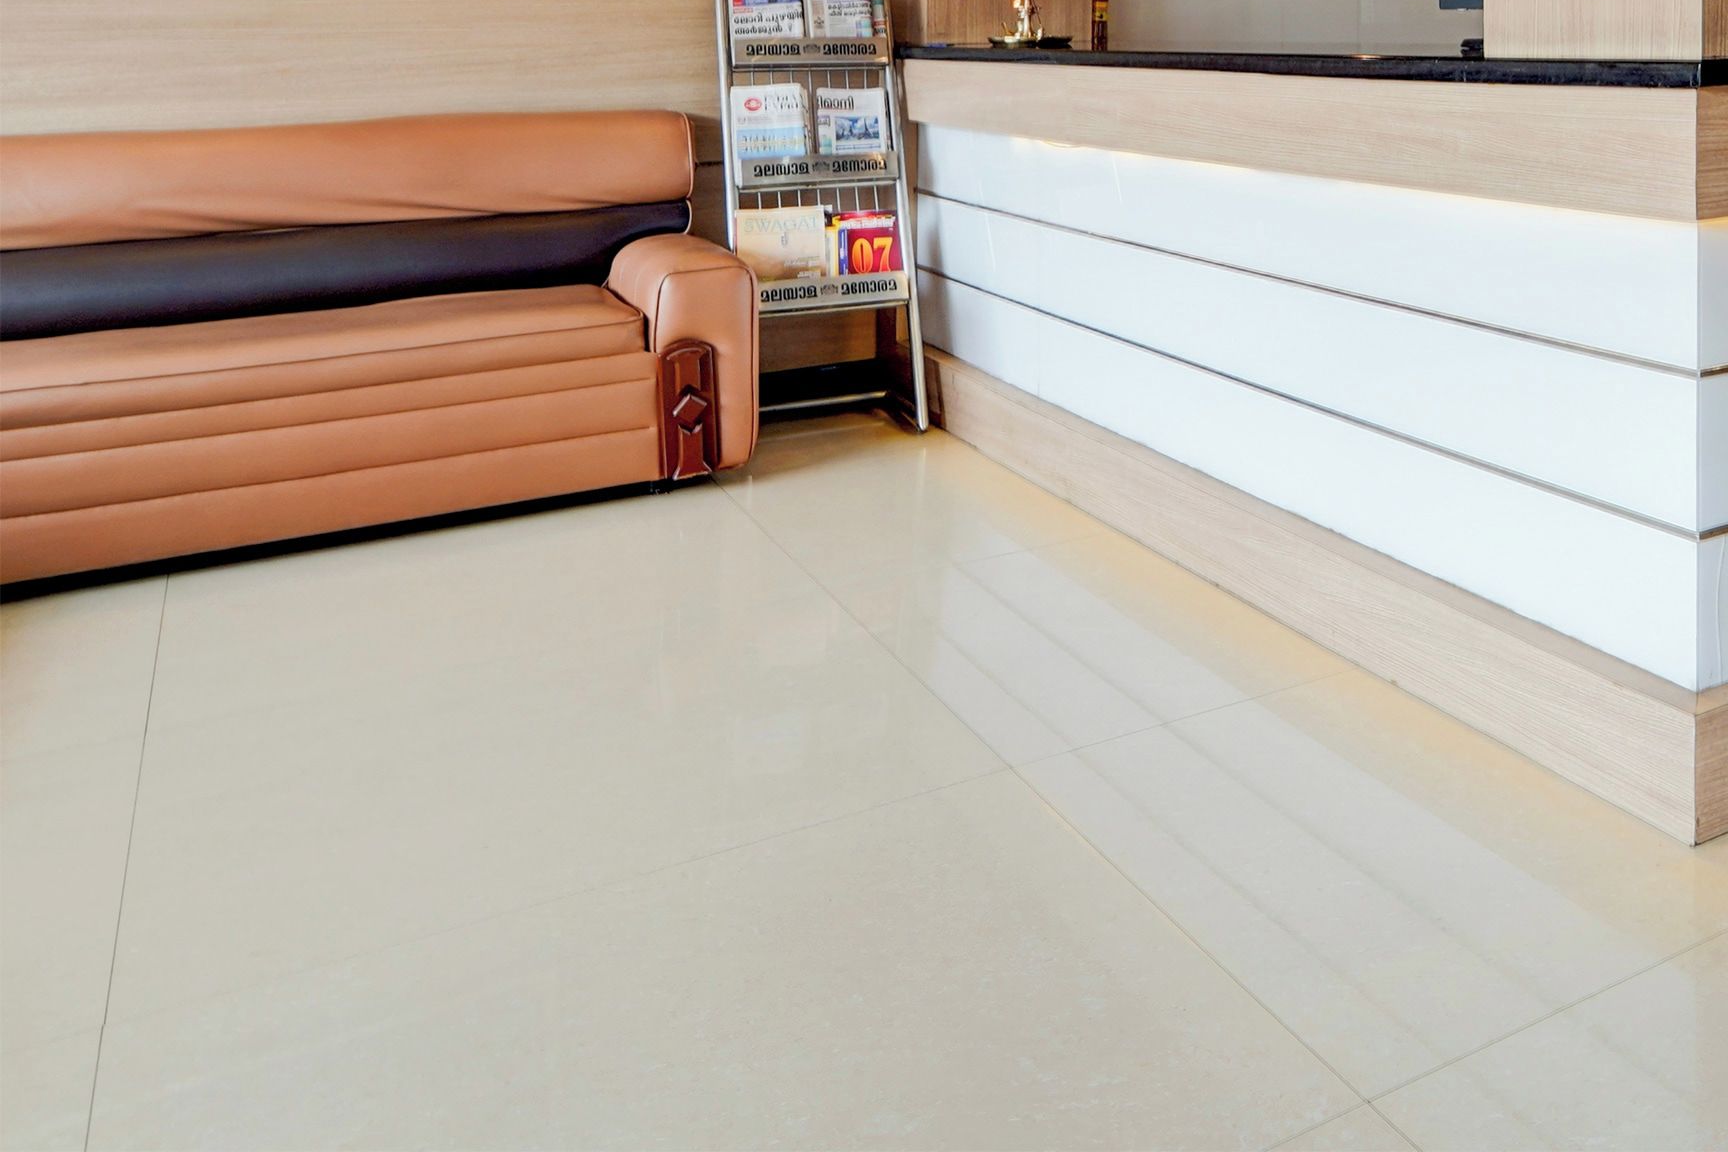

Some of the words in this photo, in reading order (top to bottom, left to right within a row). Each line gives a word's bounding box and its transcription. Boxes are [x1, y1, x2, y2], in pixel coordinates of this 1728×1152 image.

[746, 43, 801, 57] മലയാള
[822, 42, 877, 56] മനോരമ
[753, 160, 810, 177] മലയാള
[832, 158, 888, 173] മനോരമ
[852, 236, 893, 274] 07
[760, 285, 817, 303] മലയാള
[841, 278, 898, 295] മനോരമ
